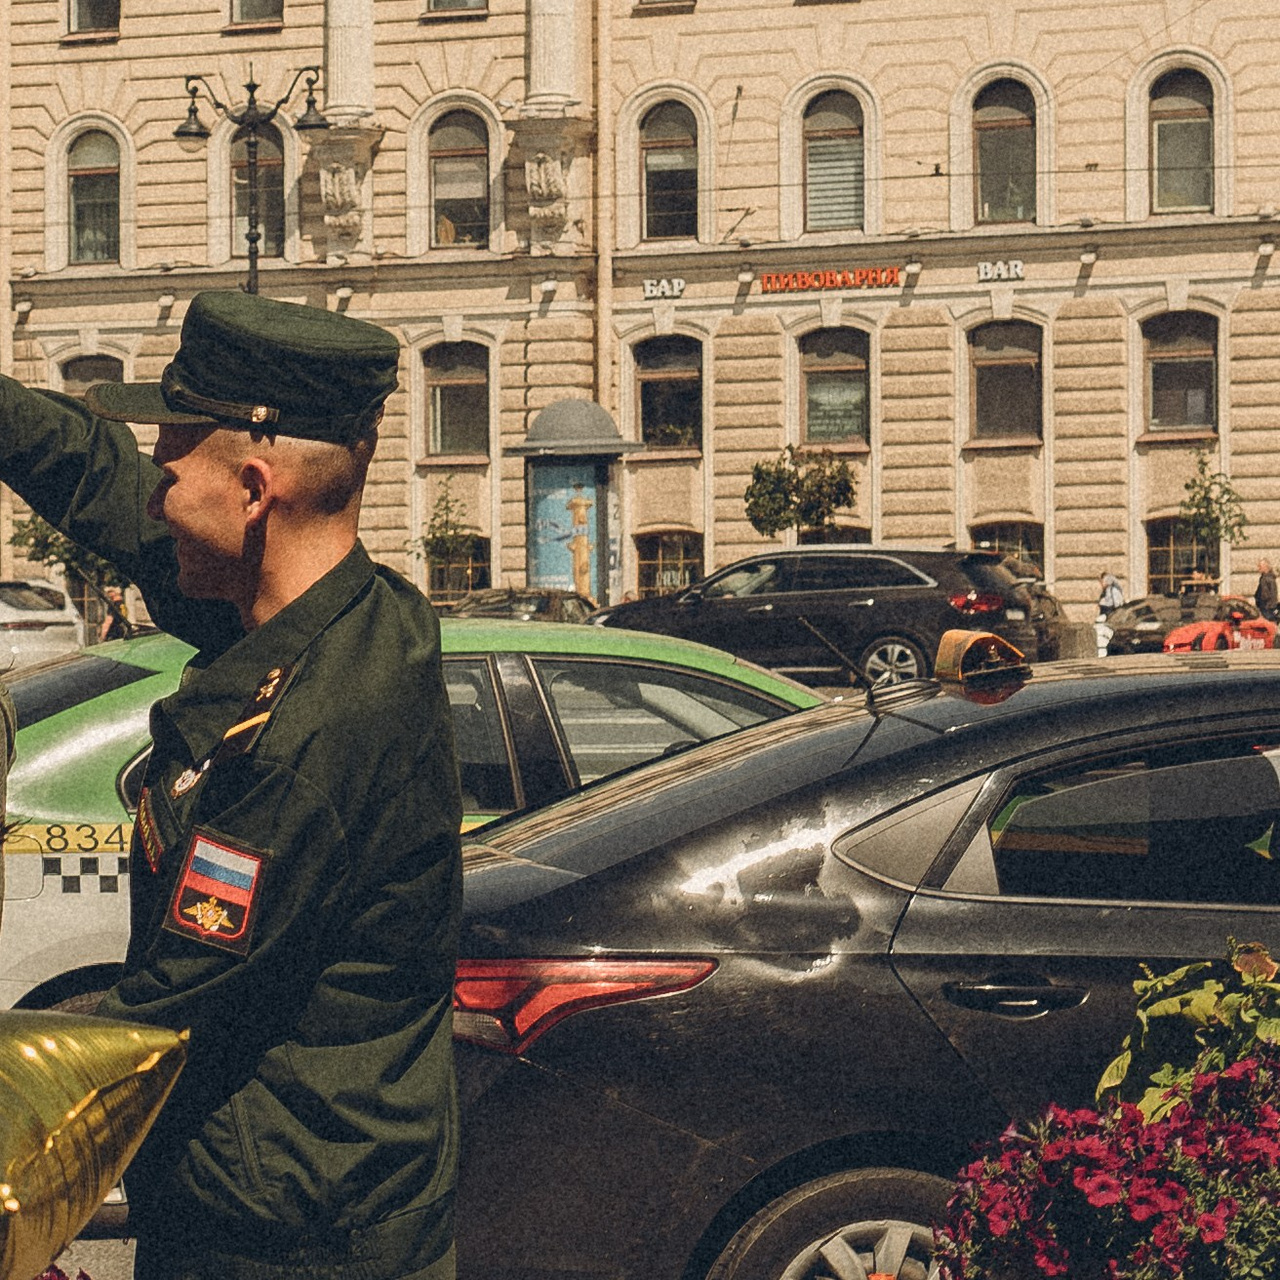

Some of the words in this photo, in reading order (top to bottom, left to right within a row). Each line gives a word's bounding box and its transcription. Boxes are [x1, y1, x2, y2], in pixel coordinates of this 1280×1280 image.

[761, 266, 901, 292] ПИВОВАРНЯ
[977, 260, 1024, 281] BAR
[644, 278, 686, 298] БАР
[45, 823, 128, 852] 834
